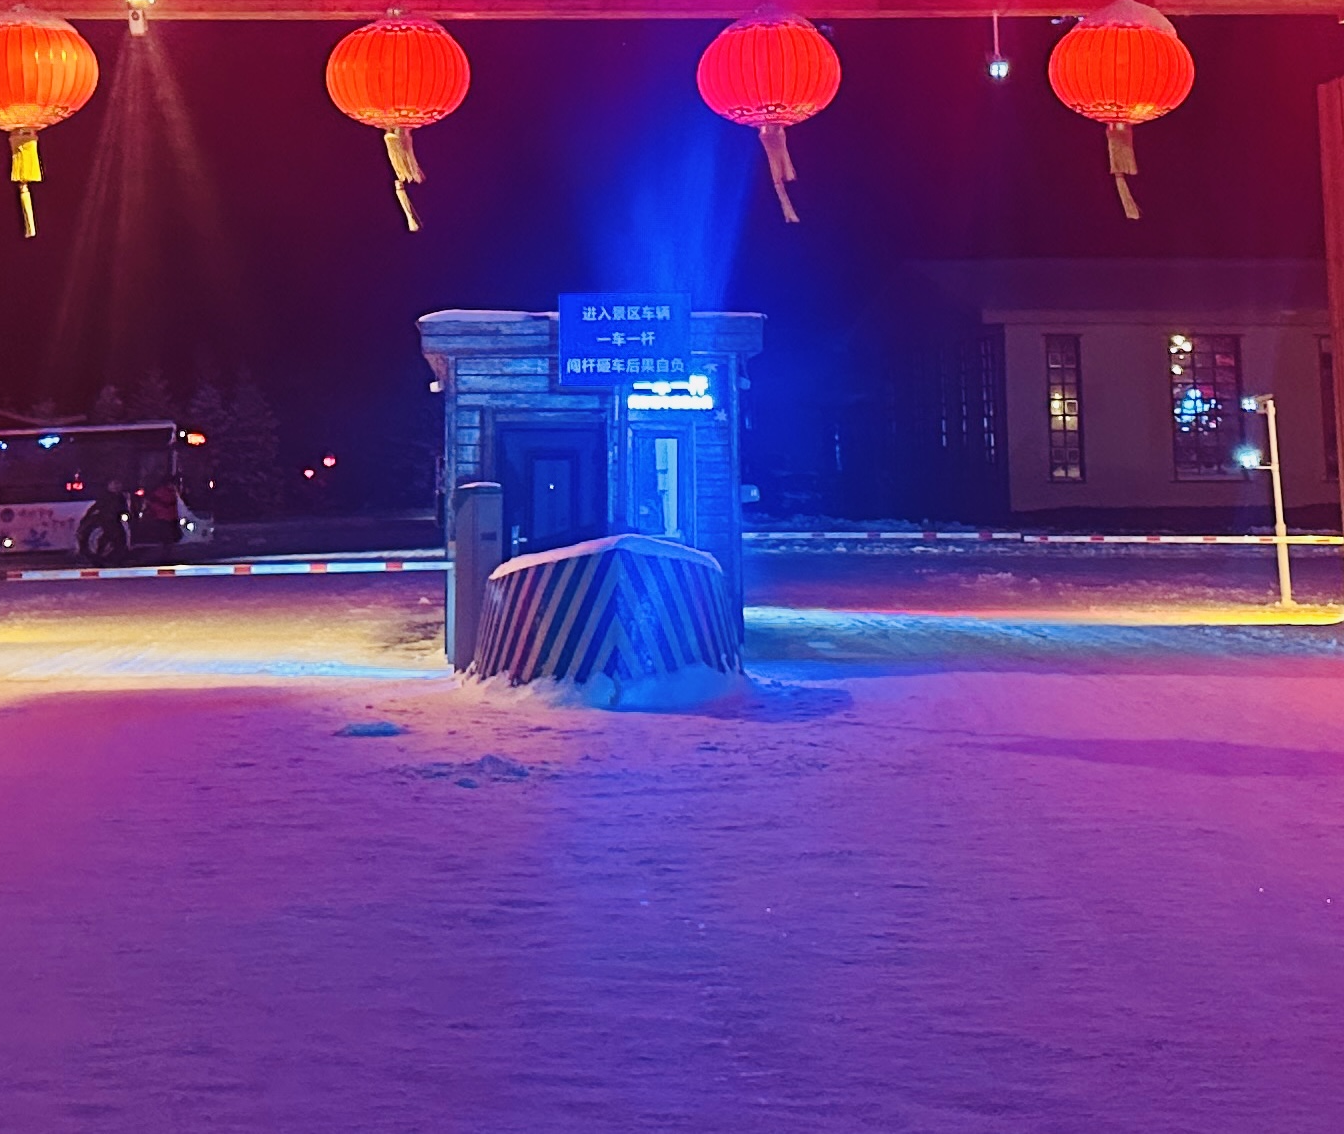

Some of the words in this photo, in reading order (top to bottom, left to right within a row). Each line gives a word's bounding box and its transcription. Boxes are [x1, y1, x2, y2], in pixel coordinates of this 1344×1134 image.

[582, 305, 670, 320] 进入景区车辆
[596, 331, 655, 346] 一车一杆
